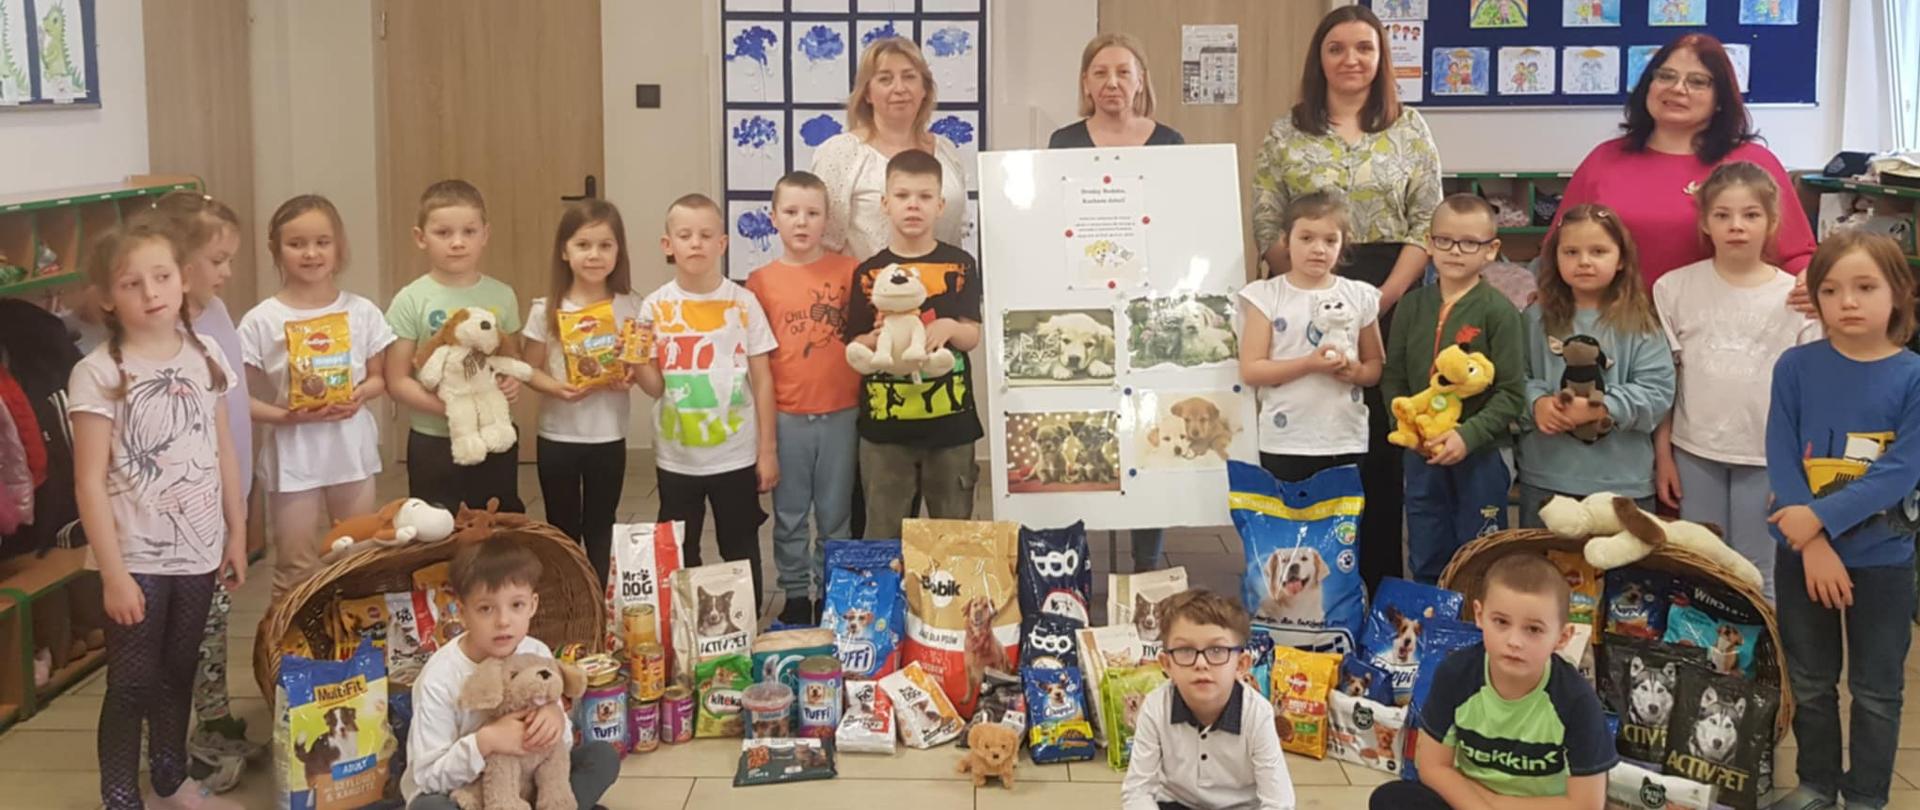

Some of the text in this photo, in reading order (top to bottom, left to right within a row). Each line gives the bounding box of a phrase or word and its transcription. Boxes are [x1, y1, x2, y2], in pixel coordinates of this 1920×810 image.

[785, 309, 808, 324] CHILL
[791, 321, 806, 335] OUT
[622, 580, 653, 597] DOG
[922, 575, 961, 597] Bobik
[710, 693, 743, 706] kiteka
